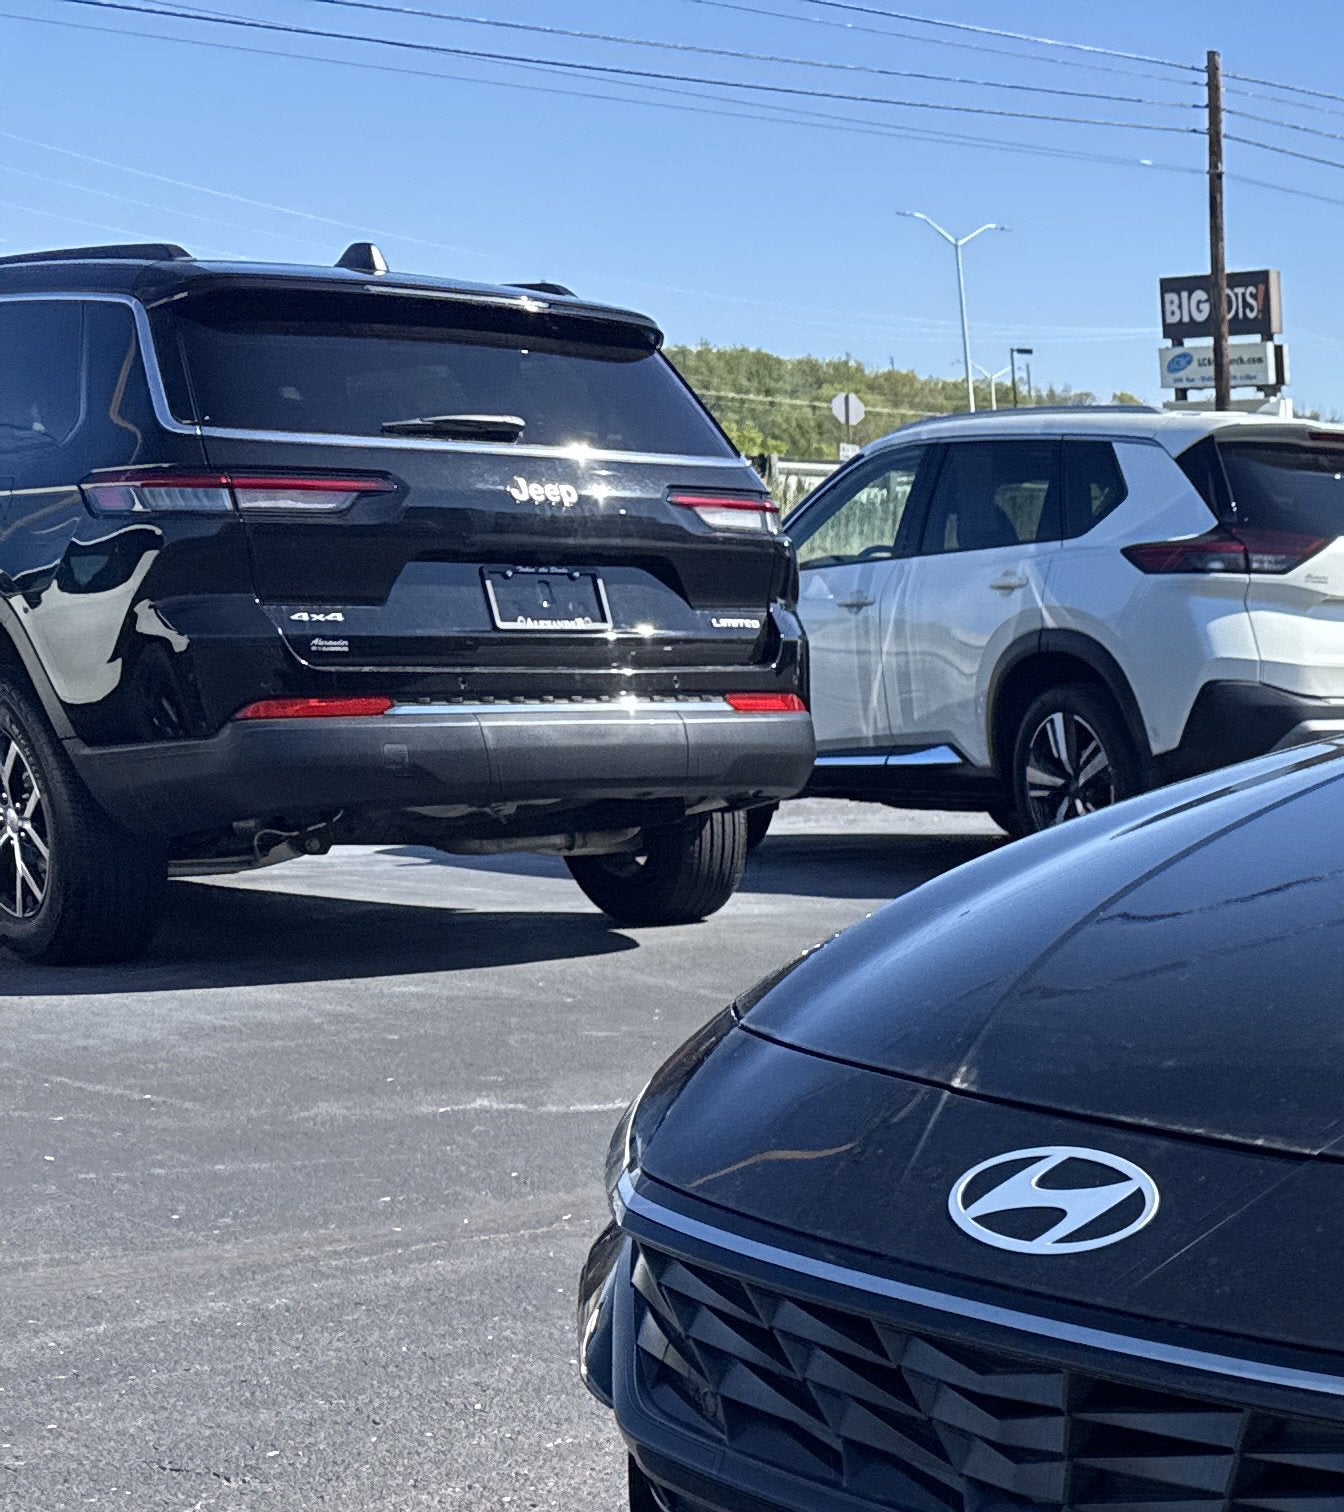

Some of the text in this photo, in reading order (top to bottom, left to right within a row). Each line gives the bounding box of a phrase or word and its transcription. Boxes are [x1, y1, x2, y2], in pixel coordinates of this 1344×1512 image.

[1164, 289, 1211, 324] BIG
[507, 476, 579, 507] Jeep
[290, 612, 345, 621] 4x4
